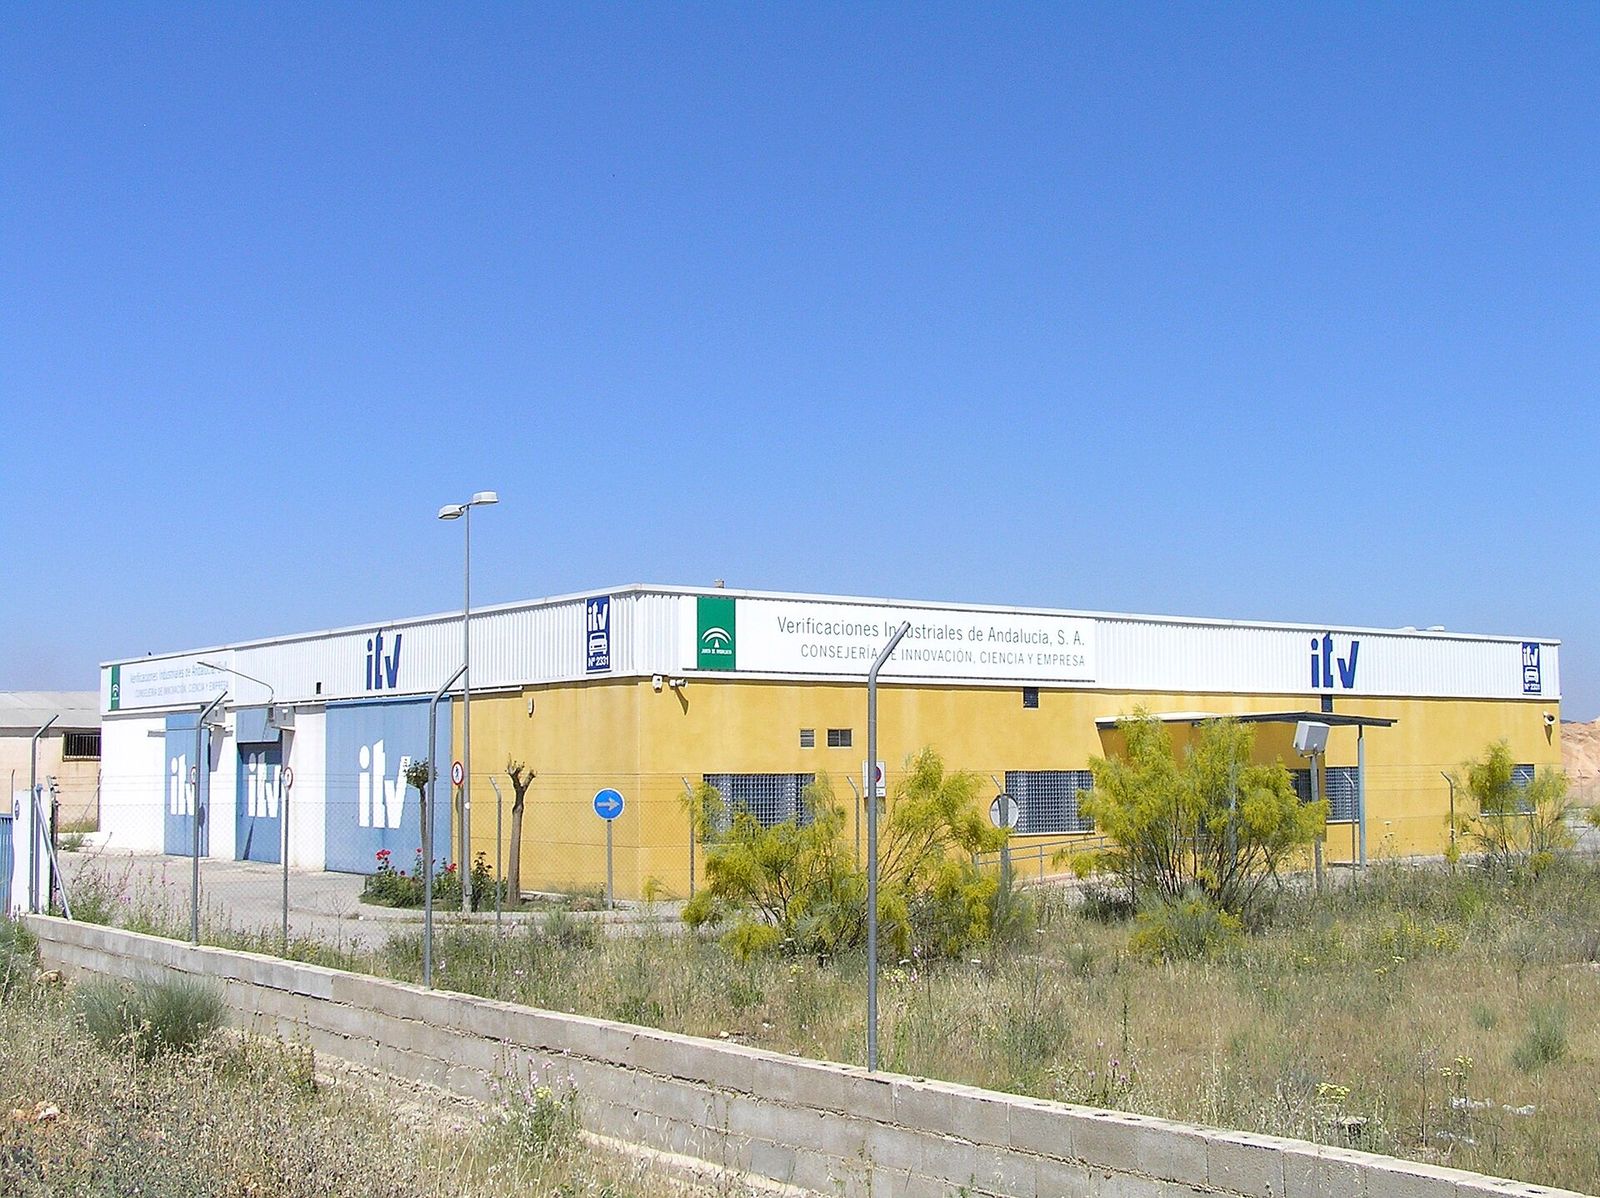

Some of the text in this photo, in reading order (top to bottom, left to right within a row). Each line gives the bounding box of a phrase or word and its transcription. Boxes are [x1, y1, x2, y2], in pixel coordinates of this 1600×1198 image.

[588, 601, 608, 631] itv
[777, 616, 879, 637] Verificaciones
[884, 620, 963, 640] Inustriales
[968, 626, 983, 641] de
[1057, 629, 1069, 645] S.
[1073, 630, 1085, 646] A.
[366, 628, 402, 690] itv
[800, 643, 879, 660] CONSEJERÍA
[901, 647, 976, 664] INNOVACIÓN,
[980, 651, 1025, 664] CIENCIA
[1027, 653, 1034, 664] Y
[1037, 653, 1085, 667] EMPRESA
[1311, 630, 1360, 688] itv
[1523, 645, 1539, 666] itv
[247, 751, 282, 818] itv
[359, 739, 411, 829] itv
